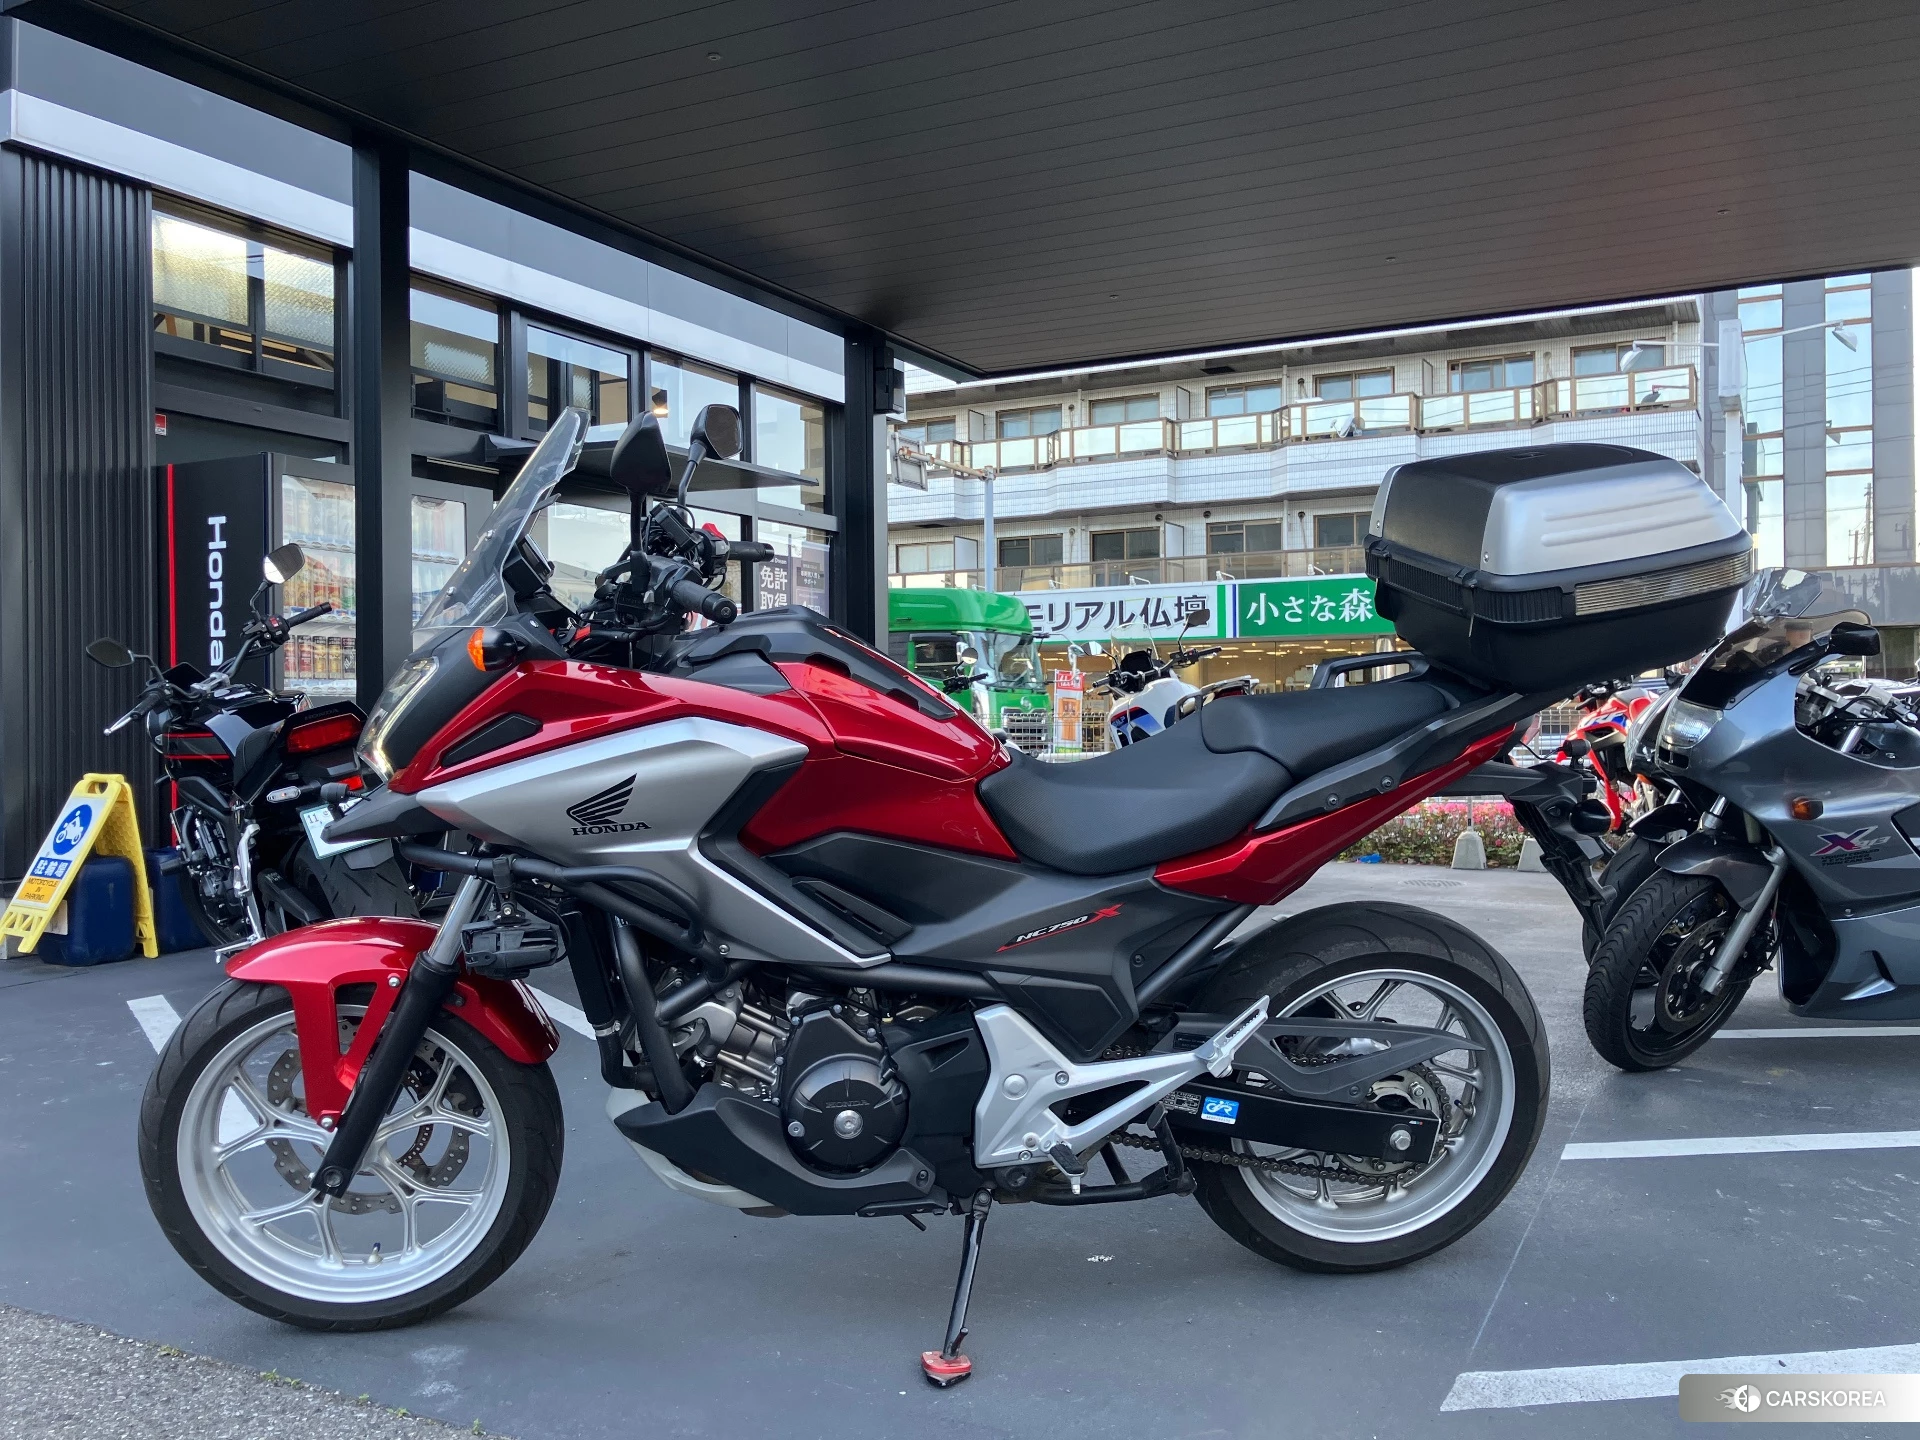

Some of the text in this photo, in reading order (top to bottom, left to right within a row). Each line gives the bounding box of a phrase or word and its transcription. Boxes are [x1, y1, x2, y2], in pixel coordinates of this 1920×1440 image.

[207, 515, 227, 666] Honda
[760, 565, 788, 591] 免許
[760, 591, 788, 610] 取得
[1246, 588, 1373, 626] 小さな森
[570, 821, 652, 836] HONDA
